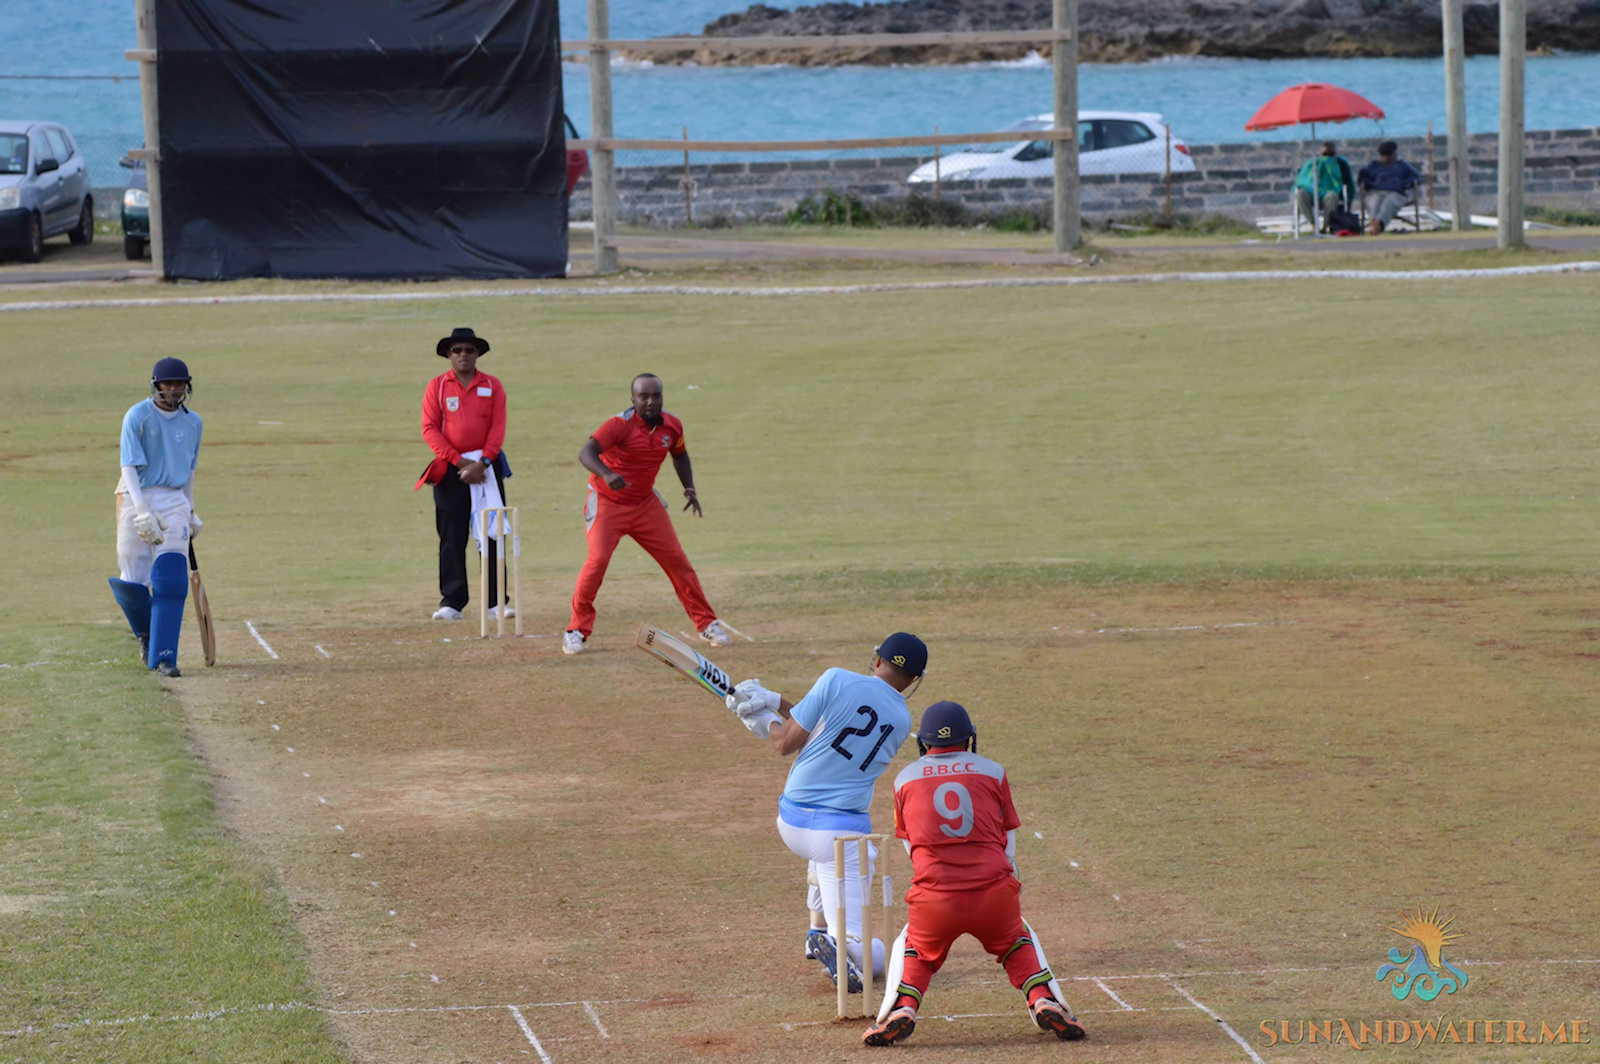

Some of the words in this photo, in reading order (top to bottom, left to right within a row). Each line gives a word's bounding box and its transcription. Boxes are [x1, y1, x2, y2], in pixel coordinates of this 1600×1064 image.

[645, 630, 656, 646] TON
[830, 705, 895, 772] 21
[932, 781, 974, 838] 9
